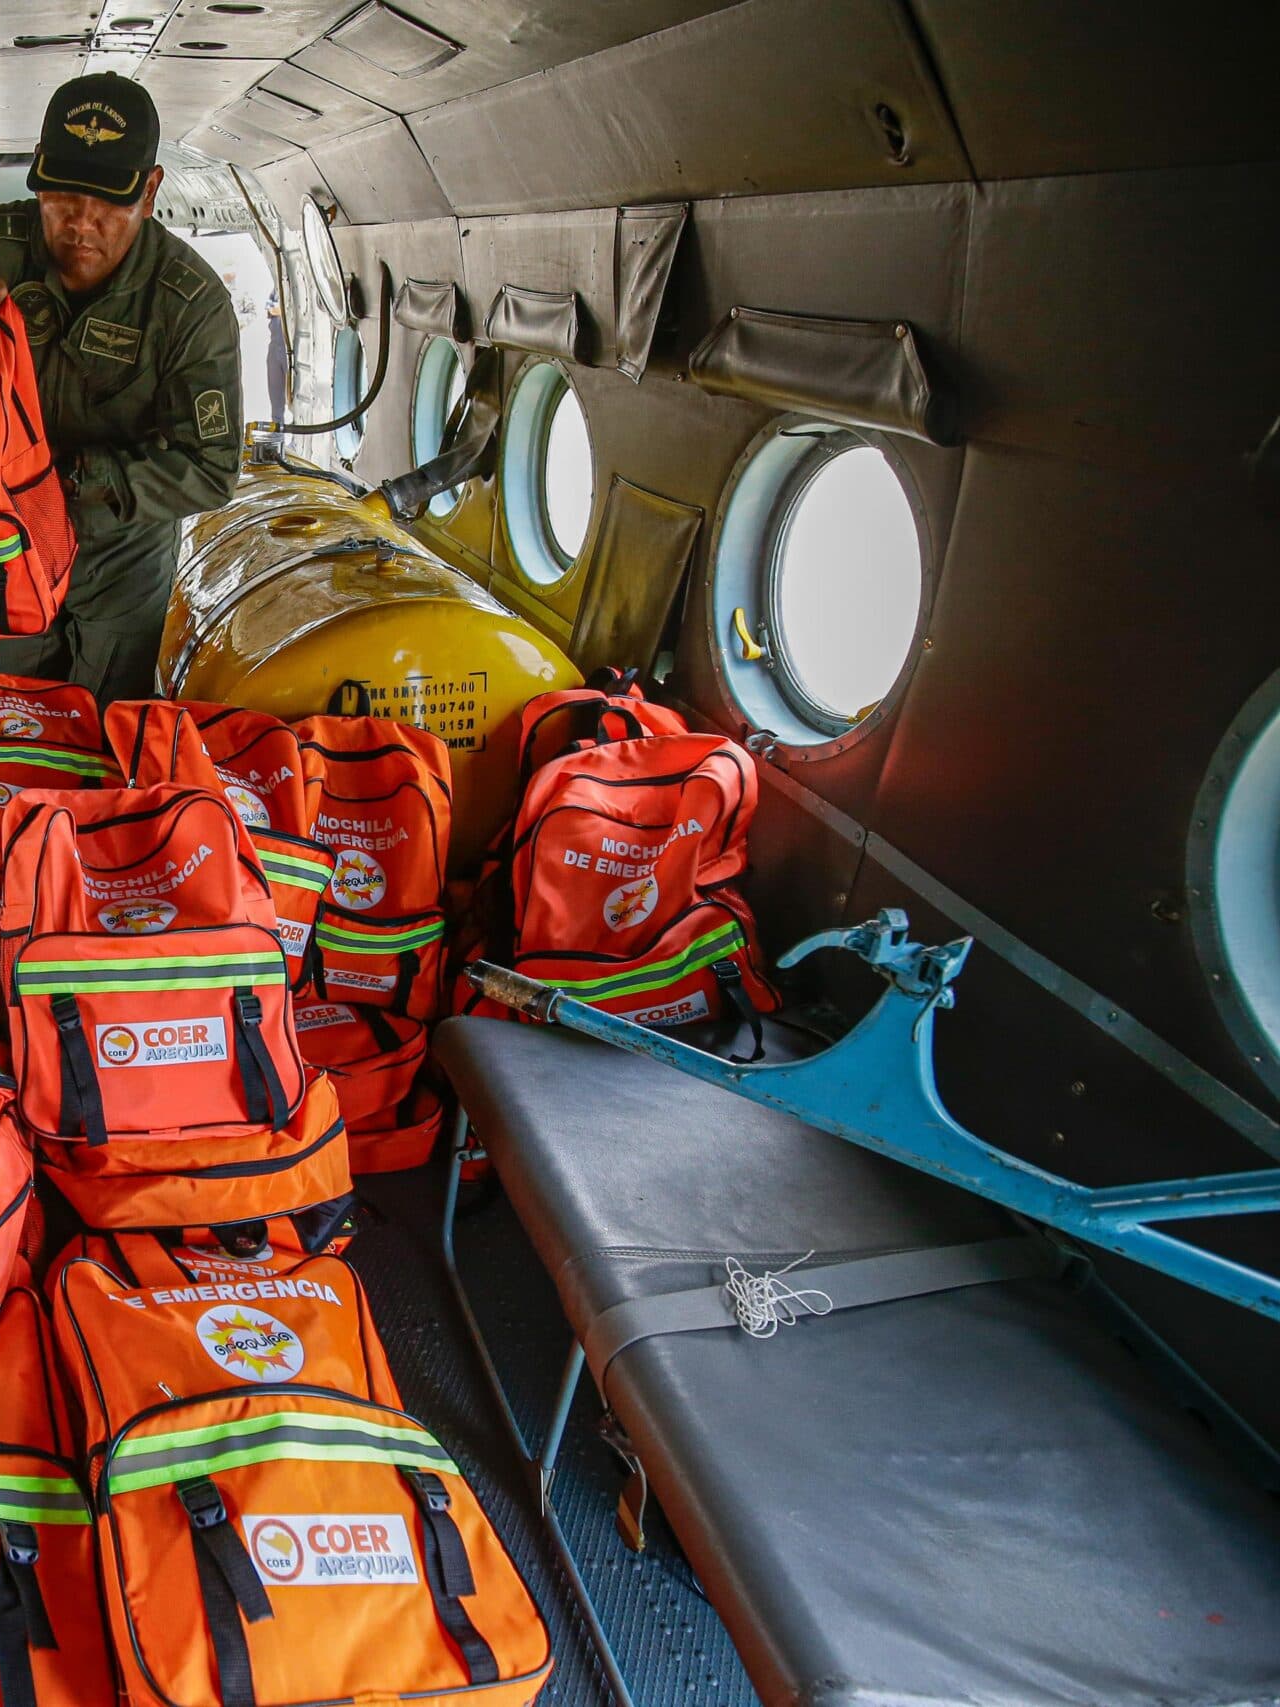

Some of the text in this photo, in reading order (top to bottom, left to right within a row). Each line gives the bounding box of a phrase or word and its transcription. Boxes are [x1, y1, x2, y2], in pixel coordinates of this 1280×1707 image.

[317, 813, 394, 833] MOCHILA
[563, 849, 592, 869] DE
[82, 844, 214, 900] EMERGENCIA
[82, 860, 177, 889] MOCHILA
[333, 971, 383, 985] COER
[634, 1002, 693, 1023] COER
[143, 1024, 209, 1047] COER
[145, 1042, 225, 1062] AREQUIPA
[151, 1279, 342, 1307] EMERGENCIA
[306, 1524, 392, 1555] COER
[266, 1558, 292, 1569] COER
[315, 1555, 415, 1580] AREQUIPA
